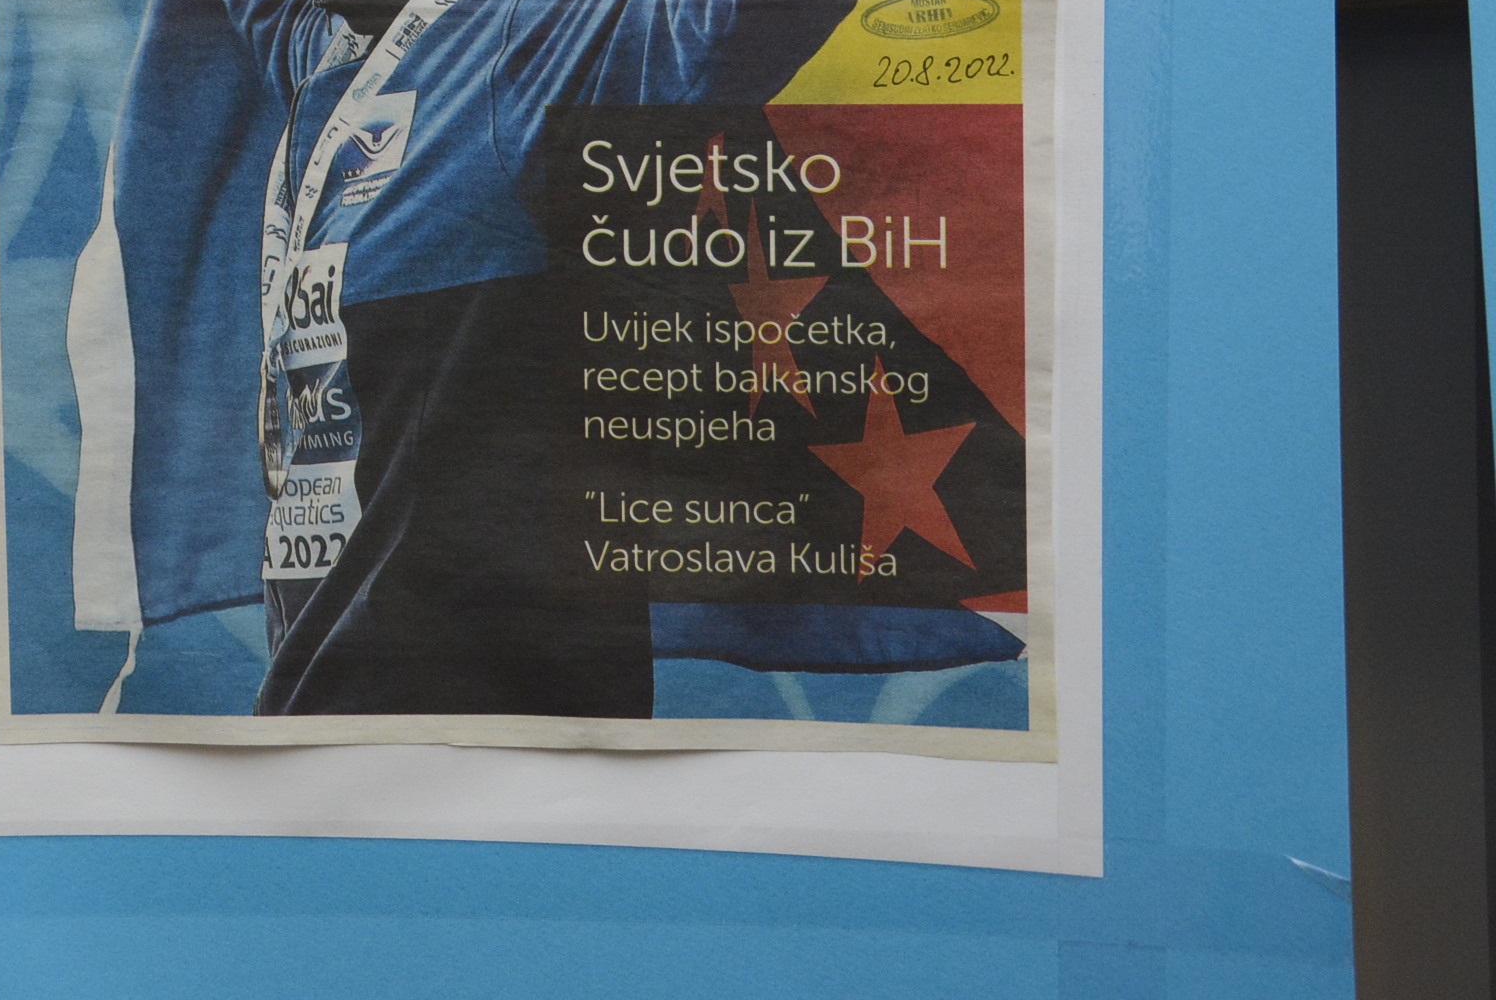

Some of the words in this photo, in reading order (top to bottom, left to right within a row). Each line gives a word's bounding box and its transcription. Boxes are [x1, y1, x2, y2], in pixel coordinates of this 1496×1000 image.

[581, 139, 842, 206] Svjetsko
[581, 213, 747, 268] čudo
[768, 214, 816, 268] iz
[840, 214, 948, 269] BiH
[582, 310, 694, 350] Uvijek
[704, 312, 897, 352] ispočetka,
[583, 363, 703, 399] recept
[714, 361, 930, 403] balkanskog
[584, 411, 777, 448] neuspjeha
[281, 477, 342, 502] opean
[585, 491, 674, 524] "Lice
[684, 493, 810, 524] sunca"
[270, 499, 345, 532] quatics
[278, 532, 347, 569] 2022
[584, 540, 777, 574] Vatroslava
[789, 541, 898, 577] Kuliša
